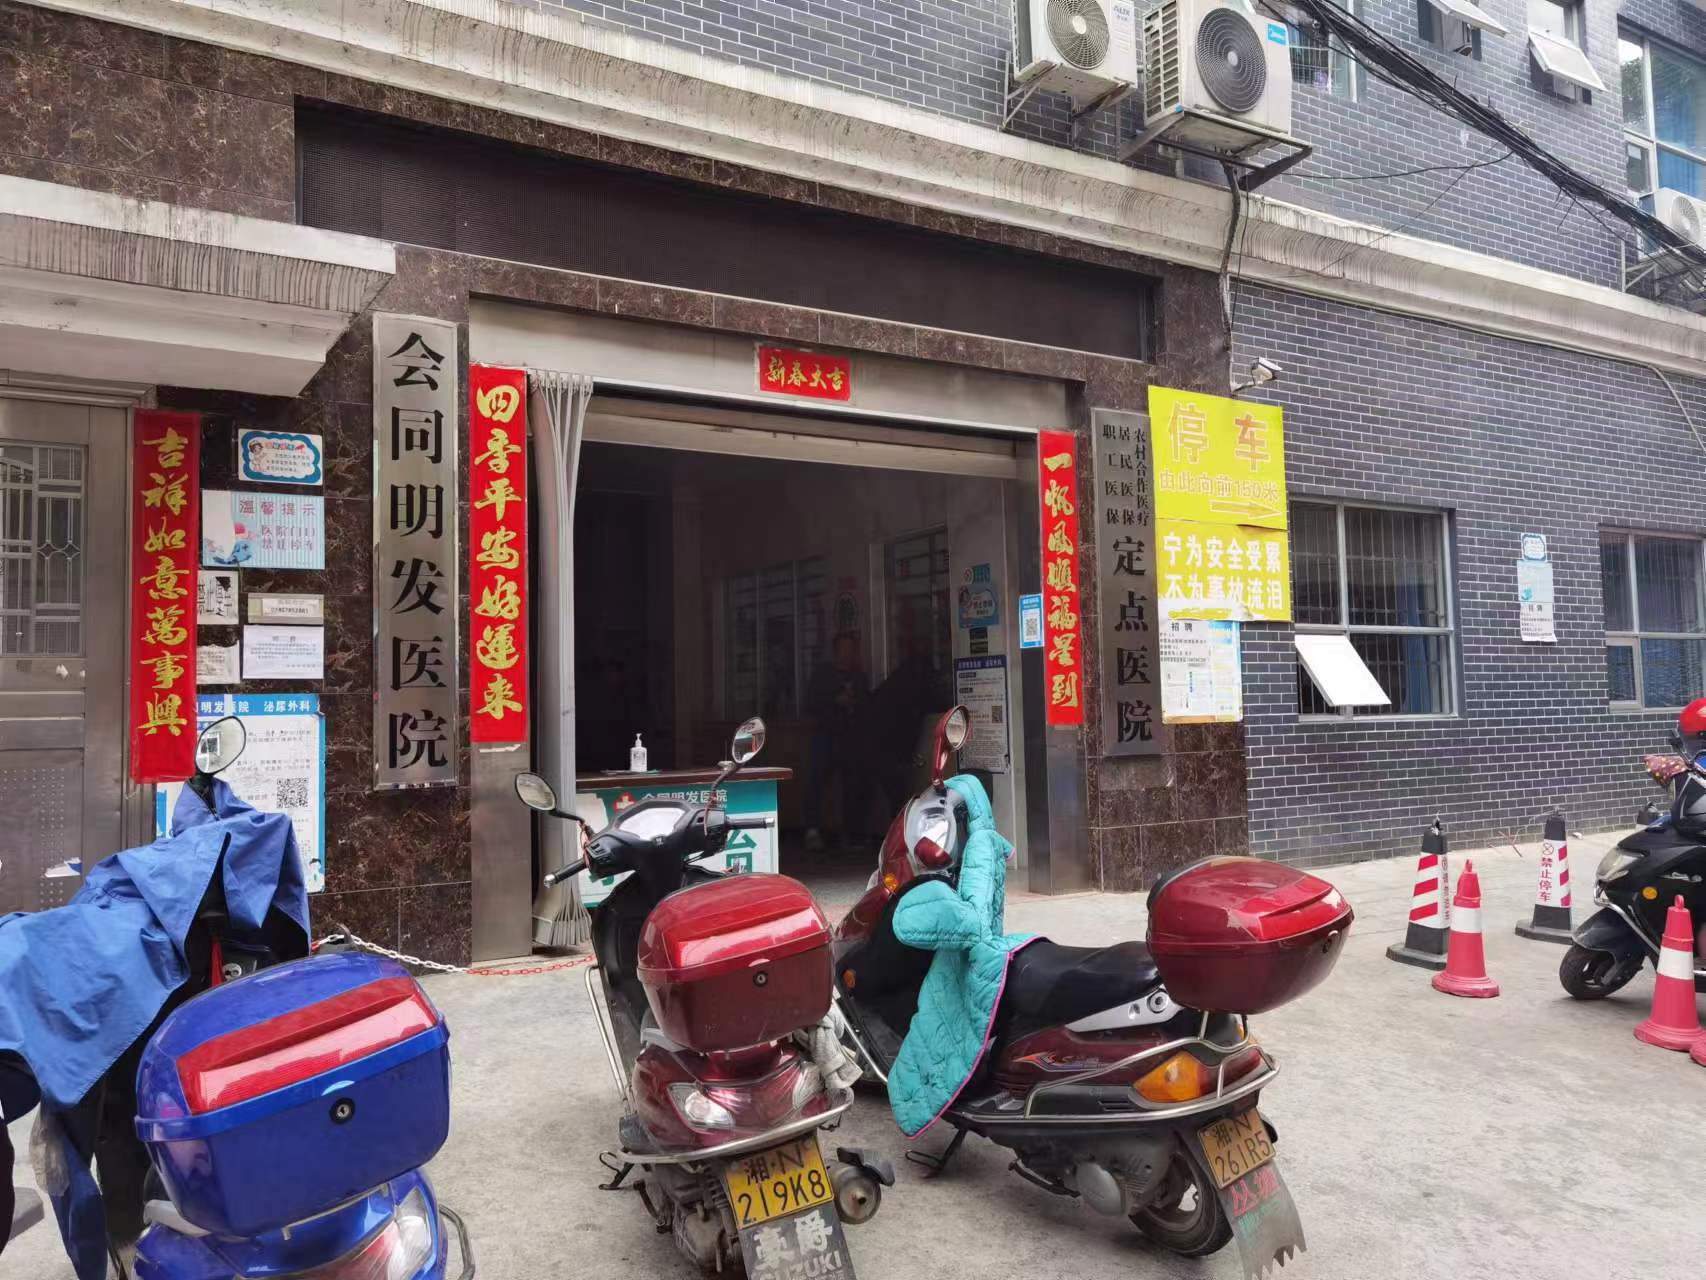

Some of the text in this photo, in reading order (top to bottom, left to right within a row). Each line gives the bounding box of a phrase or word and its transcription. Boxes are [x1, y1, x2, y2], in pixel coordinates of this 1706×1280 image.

[765, 356, 846, 391] 新春大吉
[1168, 401, 1270, 472] 停车
[1120, 426, 1134, 525] 居民医保
[1135, 428, 1149, 526] 农村合作医疗
[240, 500, 315, 516] 温馨提示
[386, 332, 448, 770] 会同明发医院
[1163, 531, 1281, 573] 宁为安全受累
[1164, 573, 1283, 610] 不为事故流泪
[1113, 536, 1153, 743] 定点医院
[264, 701, 310, 713] 泌尿外科
[1539, 857, 1553, 902] 禁止停车
[1215, 1131, 1271, 1183] 261R5
[738, 1170, 825, 1224] 219K8
